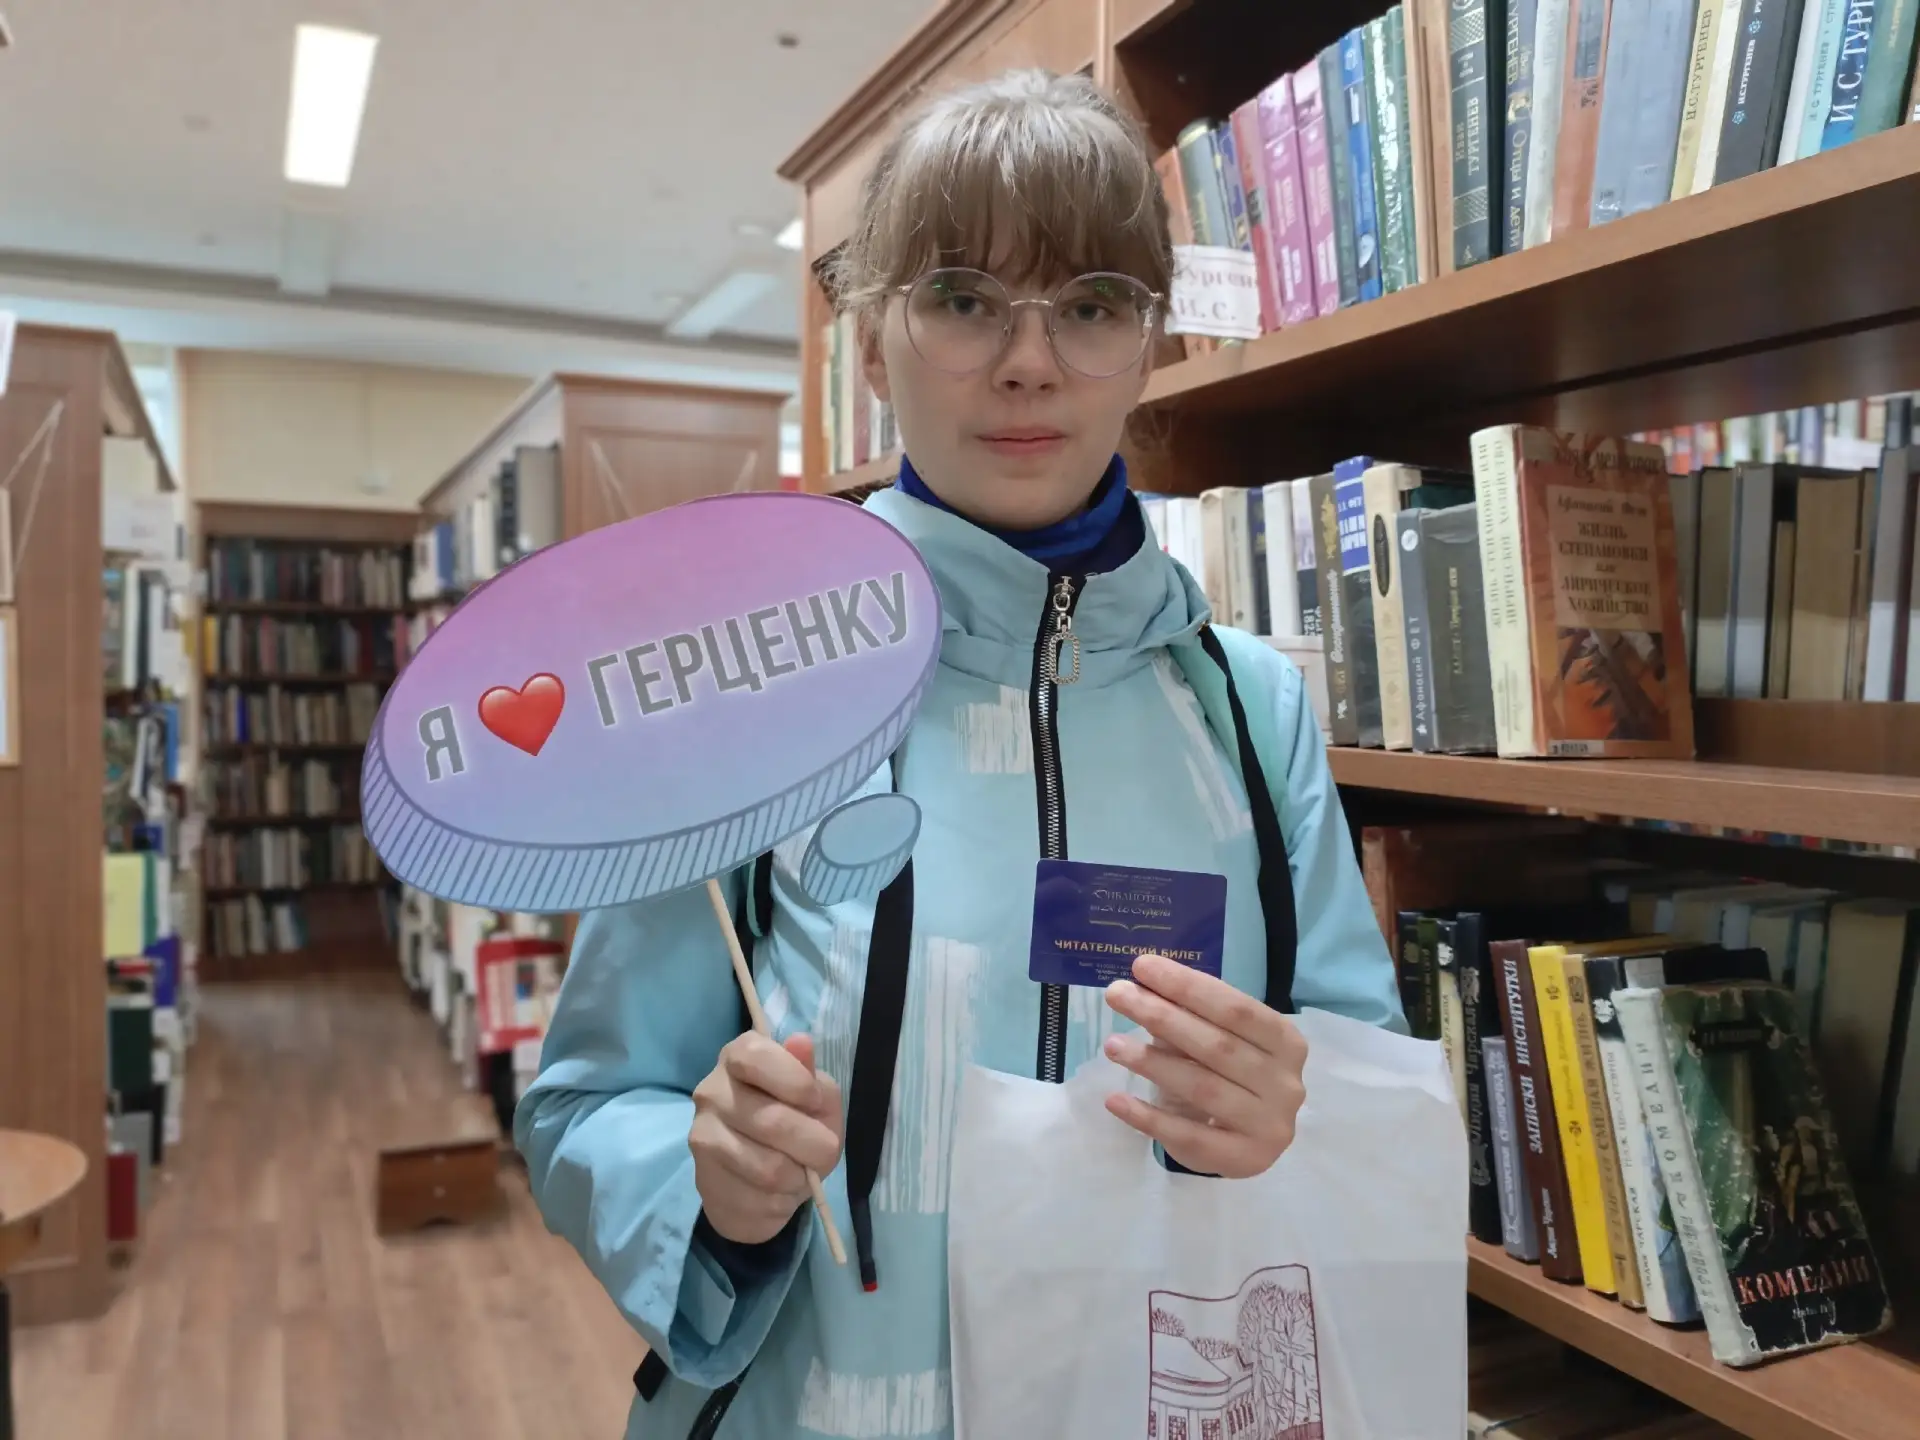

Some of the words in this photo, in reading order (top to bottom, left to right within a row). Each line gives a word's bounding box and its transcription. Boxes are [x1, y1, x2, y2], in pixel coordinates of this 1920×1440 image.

[1685, 8, 1712, 121] И.С.ТУРГЕНЕВ
[1837, 63, 1864, 90] С.
[1829, 95, 1859, 123] И.
[1466, 97, 1481, 176] ТУРГЕНЕВ
[1510, 129, 1528, 182] Отцы
[1212, 301, 1237, 321] С.
[1558, 541, 1649, 561] СТЕПАНОВКИ
[1577, 521, 1628, 540] ЖИЗНЬ
[1561, 576, 1652, 597] ЛИРИЧЕСКОЕ
[1568, 597, 1649, 616] ХОЗЯЙСТВО
[1408, 615, 1422, 651] ФЕТ
[418, 705, 465, 781] Я
[587, 571, 909, 727] ГЕРЦЕНКУ
[1411, 655, 1428, 721] Афанасий
[1054, 939, 1158, 956] ЧИТАТЕЛЬСКИЙ
[1160, 949, 1203, 961] БИЛЕТ
[1502, 957, 1532, 1067] ИНСТИТУТКИ
[1463, 1005, 1482, 1074] Чарская
[1519, 1075, 1544, 1154] ЗАПИСКИ
[1629, 1186, 1647, 1249] ЧАРСКАЯ
[1736, 1254, 1871, 1306] КОМЕДИИ
